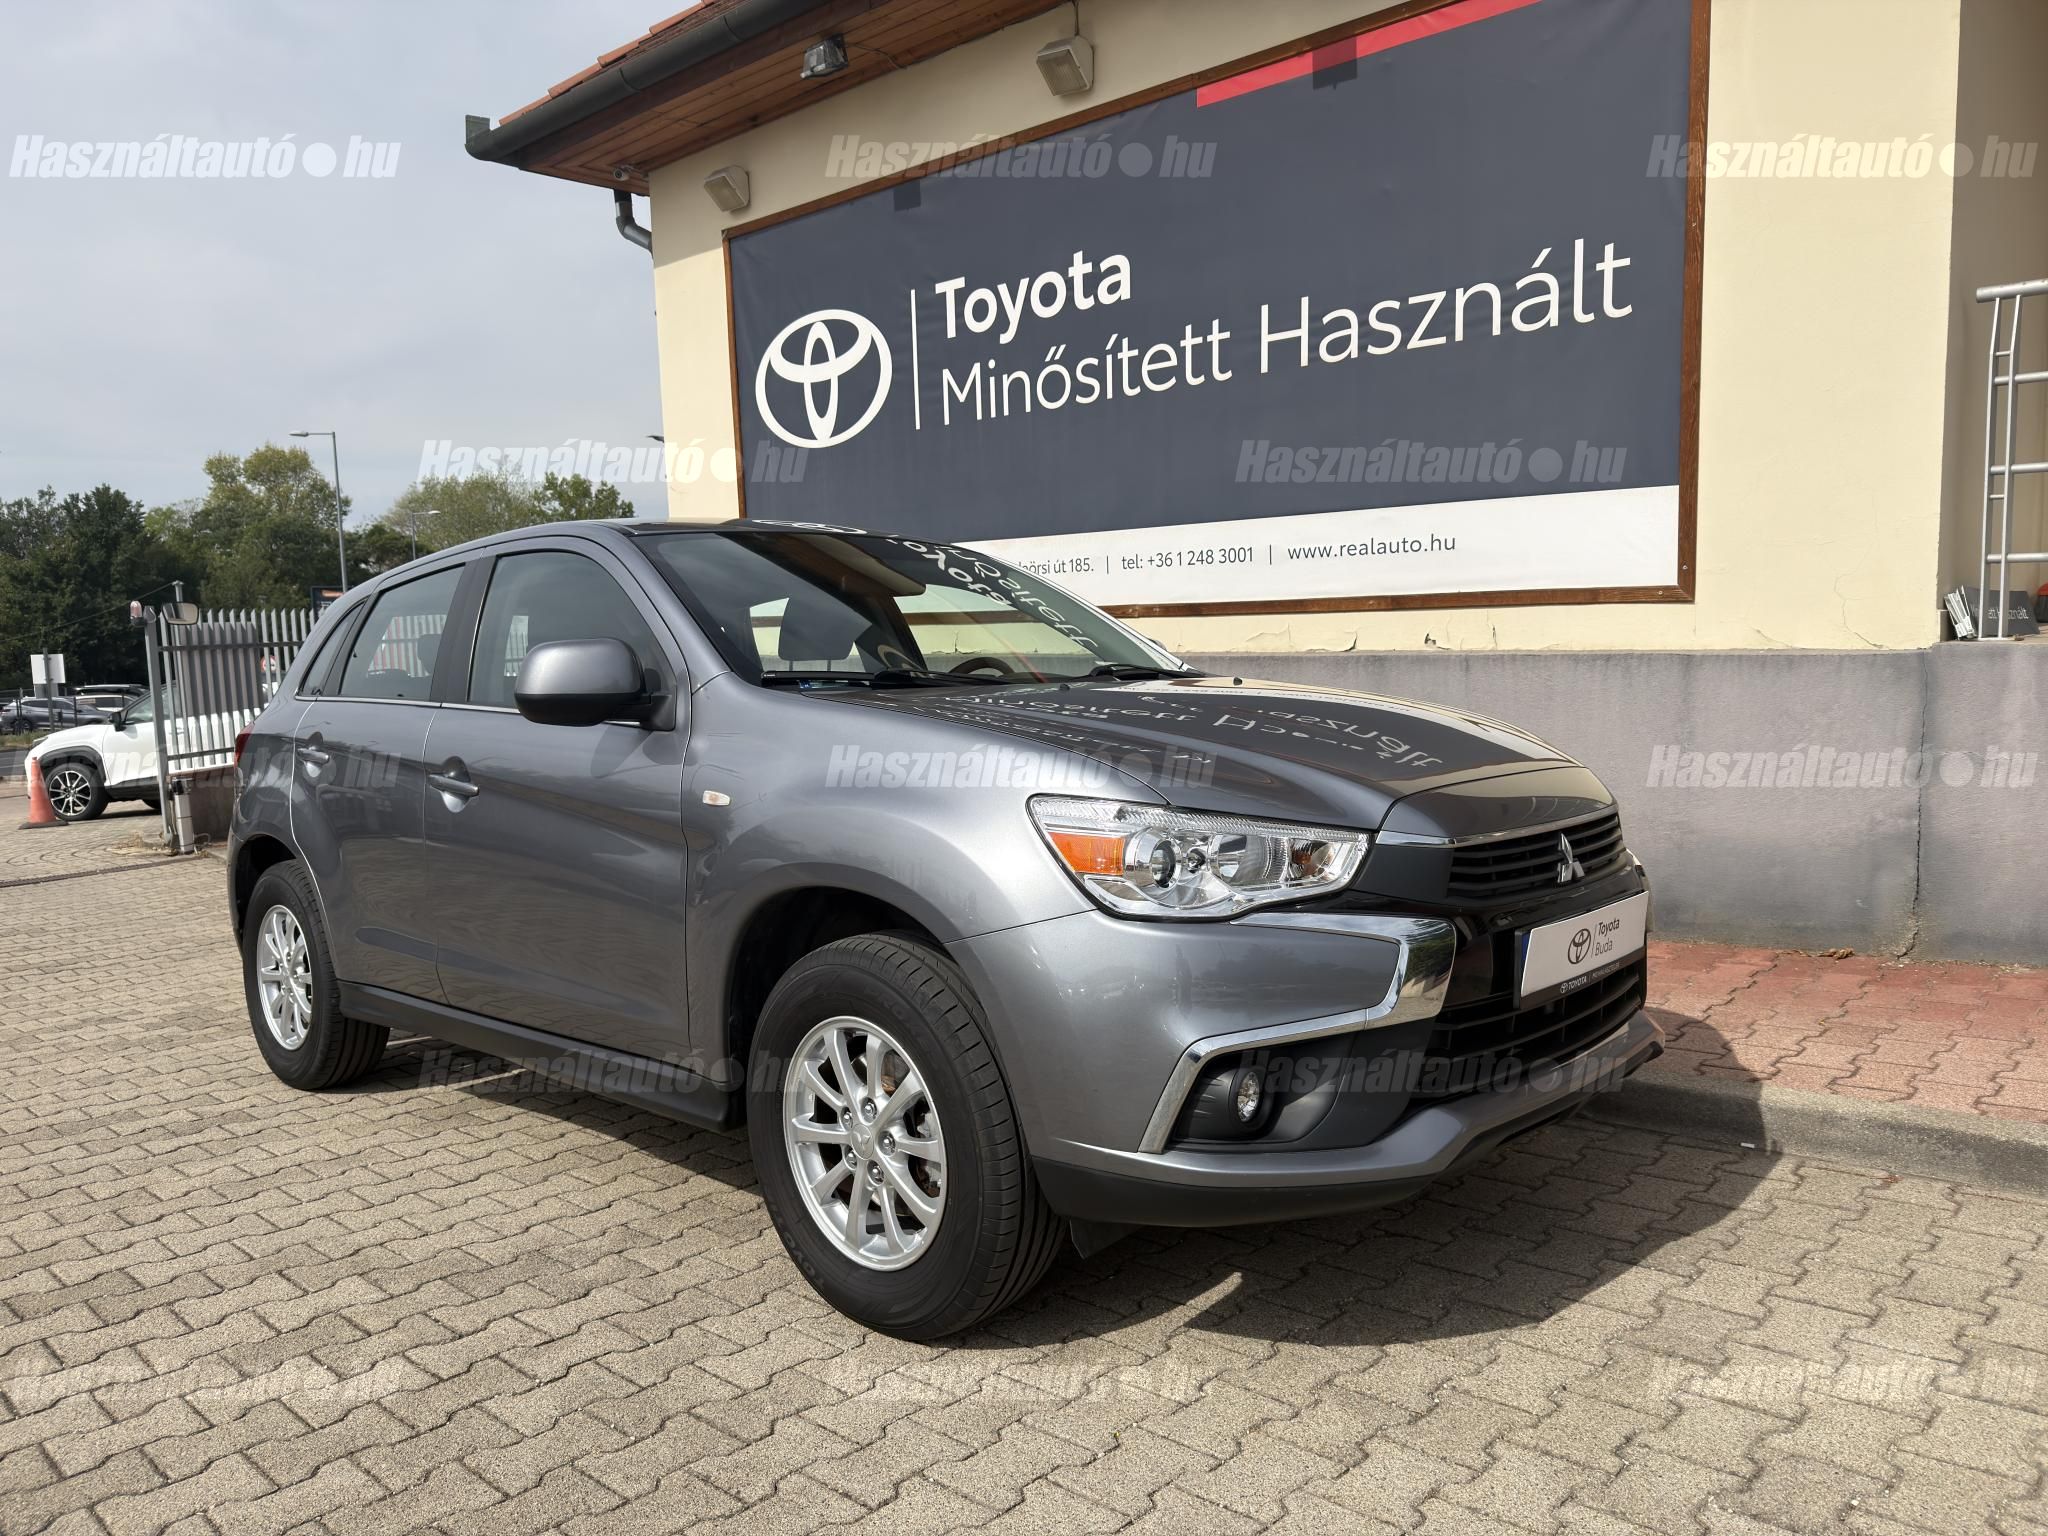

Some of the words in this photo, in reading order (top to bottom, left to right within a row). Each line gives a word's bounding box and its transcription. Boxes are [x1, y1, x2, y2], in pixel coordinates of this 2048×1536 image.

[935, 250, 1131, 344] Toyota
[942, 318, 1233, 426] Minősített
[1260, 238, 1633, 374] Használt
[1018, 560, 1050, 575] örsi
[1053, 558, 1067, 573] út
[1069, 557, 1094, 572] 185.
[1122, 553, 1143, 569] tel:
[1147, 551, 1173, 568] +36
[1177, 551, 1183, 566] 1
[1187, 549, 1214, 566] 248
[1218, 546, 1254, 563] 3001
[1287, 533, 1456, 560] www.realauto.hu
[1595, 938, 1613, 956] Buda
[1598, 917, 1621, 938] Toyota
